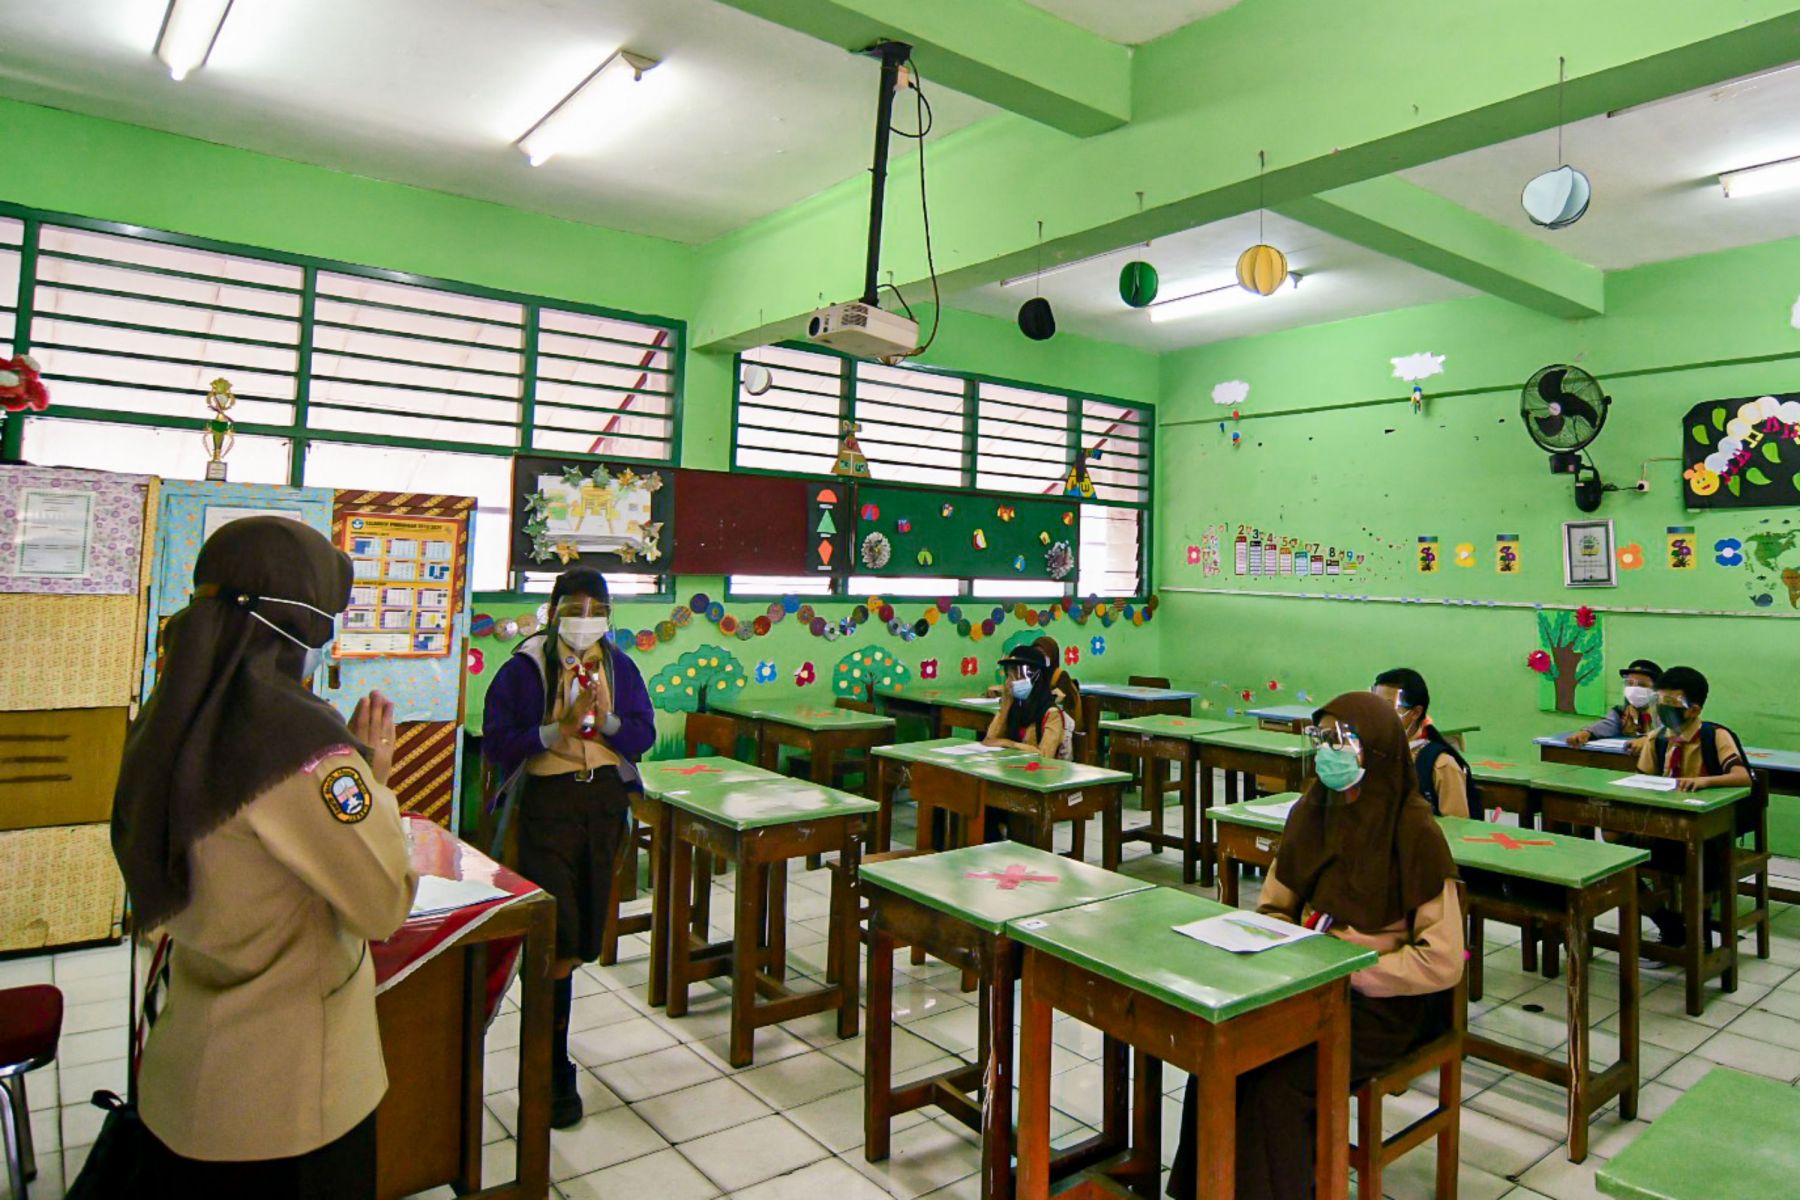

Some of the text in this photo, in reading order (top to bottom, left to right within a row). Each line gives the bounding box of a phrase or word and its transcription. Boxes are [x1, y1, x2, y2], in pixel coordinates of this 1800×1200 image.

[1238, 525, 1244, 534] 2
[1252, 529, 1259, 539] 3
[1267, 533, 1273, 542] 4
[1282, 536, 1288, 546] 5
[1313, 543, 1320, 554] 7
[1329, 547, 1336, 557] 8
[1346, 550, 1354, 561] 9
